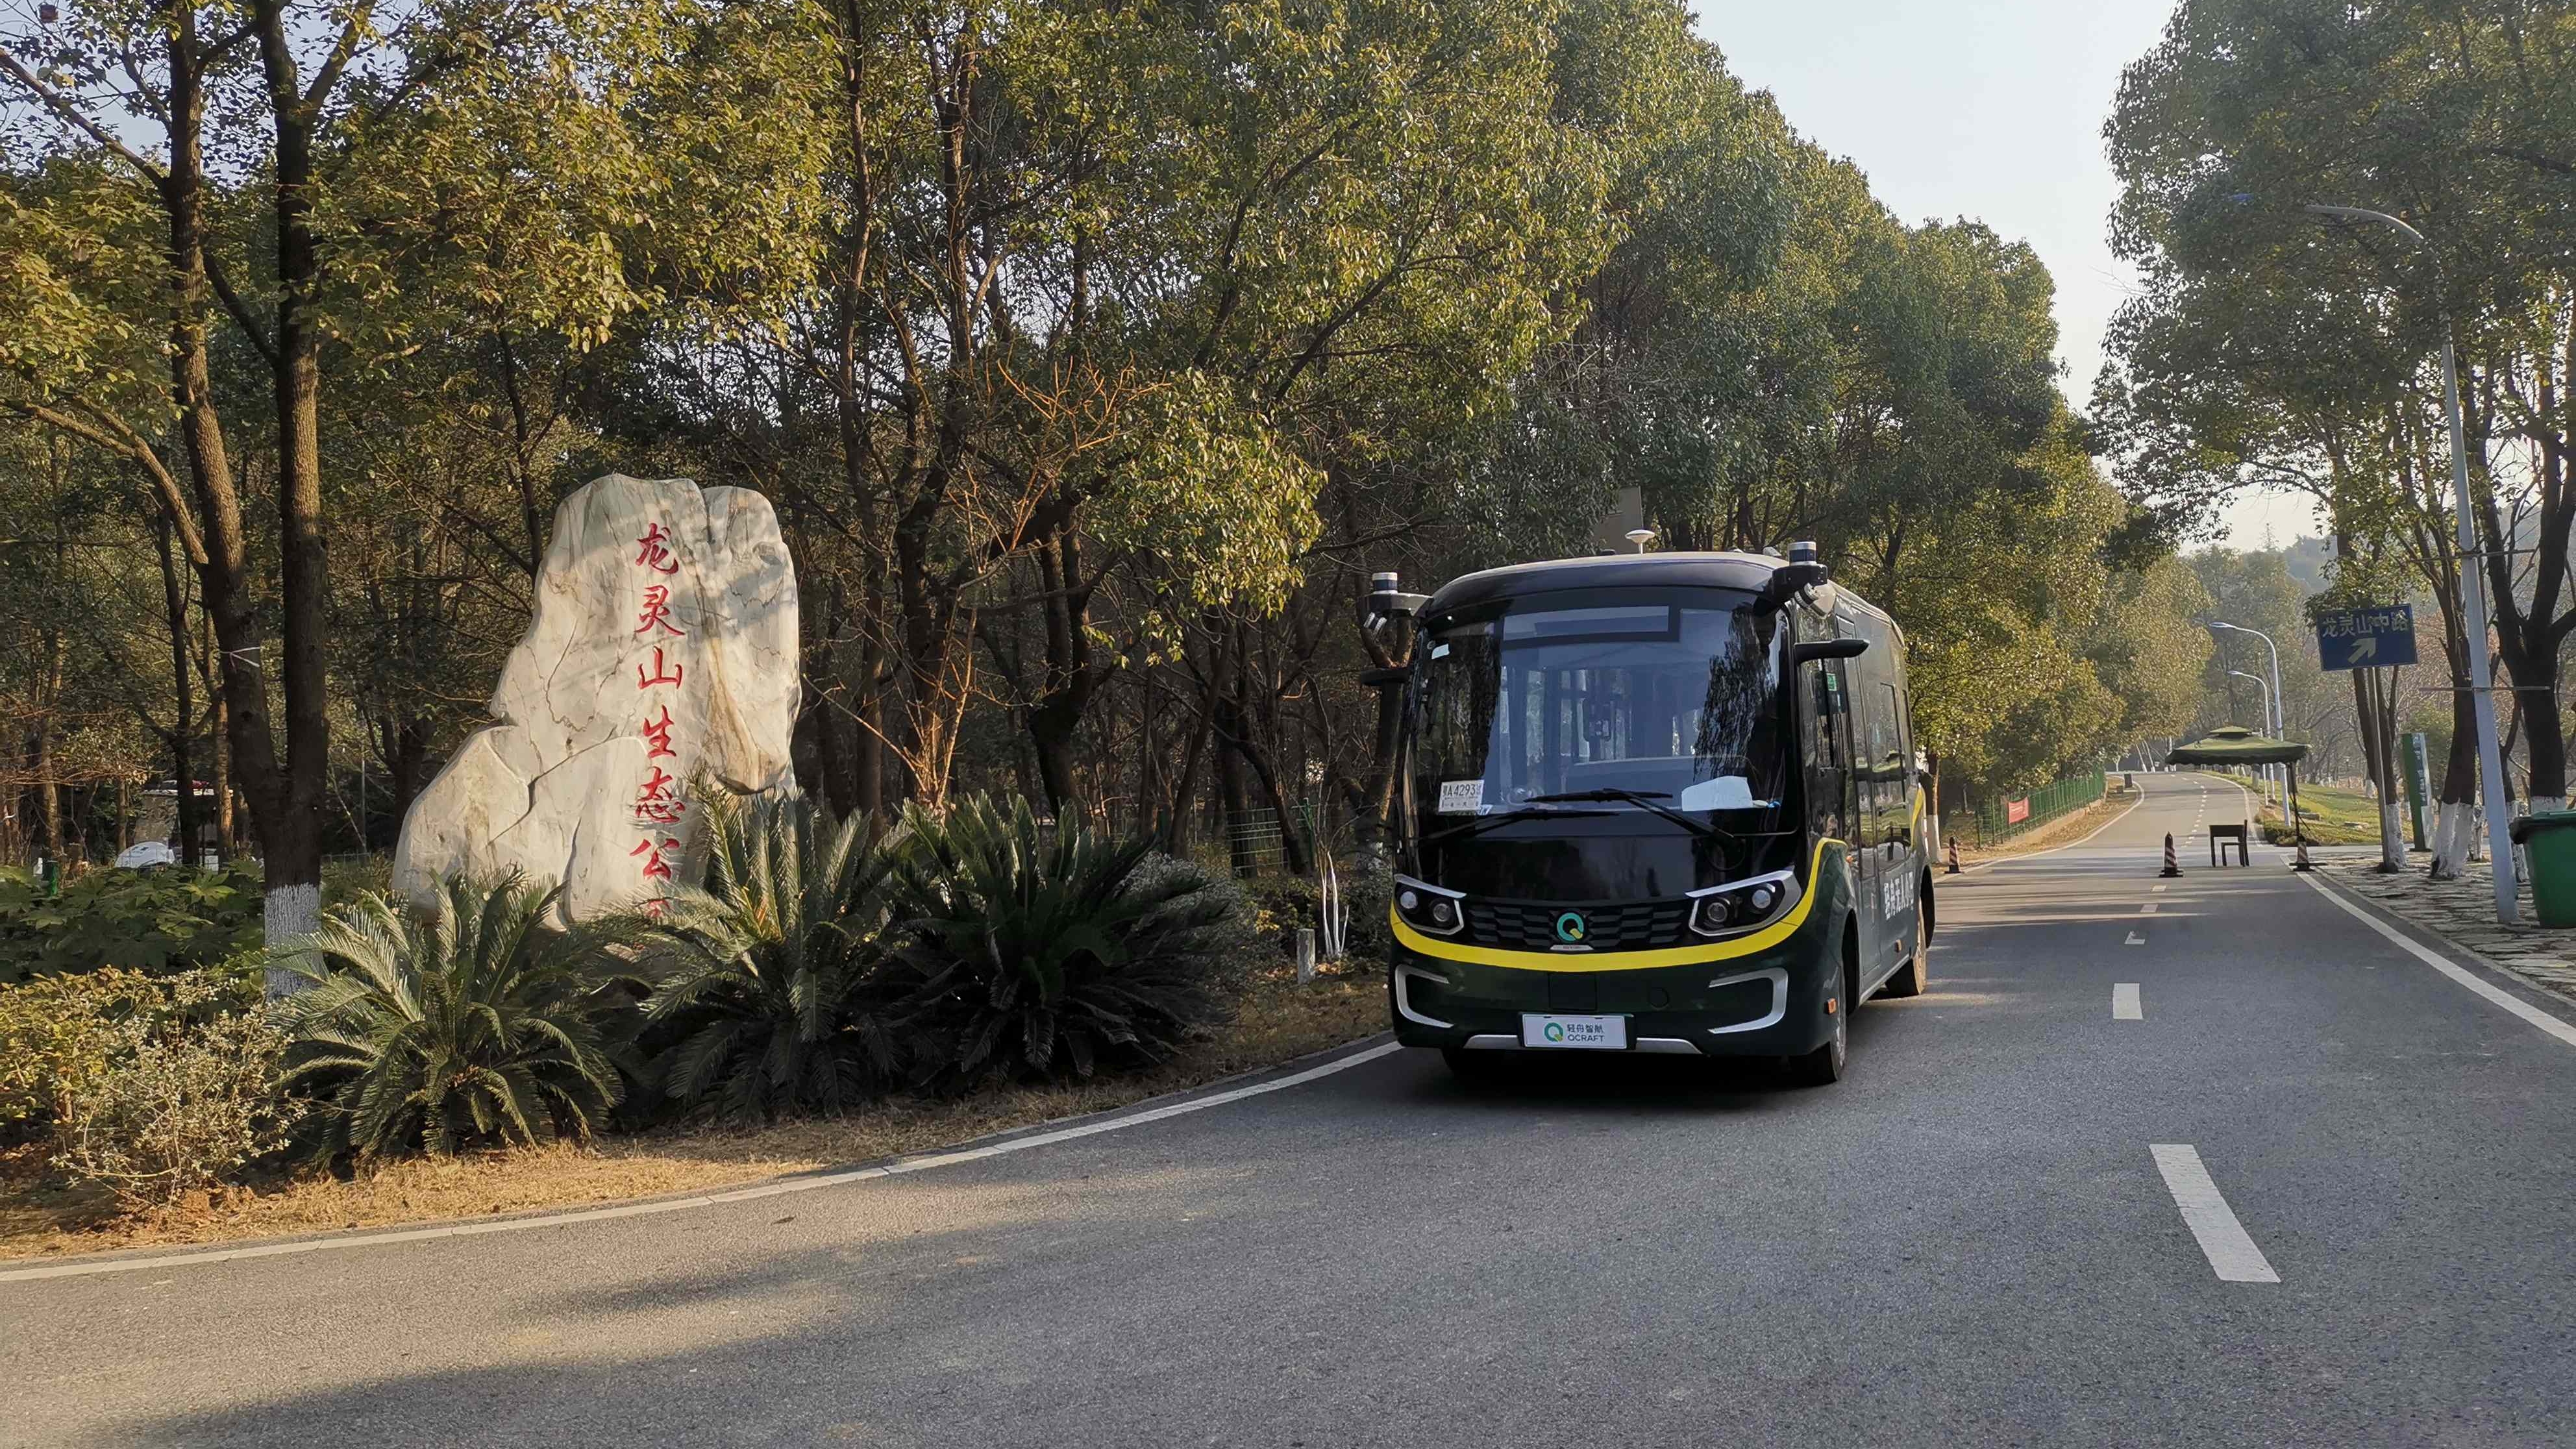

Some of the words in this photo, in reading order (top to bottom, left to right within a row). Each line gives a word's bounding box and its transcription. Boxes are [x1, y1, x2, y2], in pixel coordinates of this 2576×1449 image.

[2322, 609, 2409, 638] 龙灵山中路
[1567, 1023, 1604, 1034] 轻舟智航
